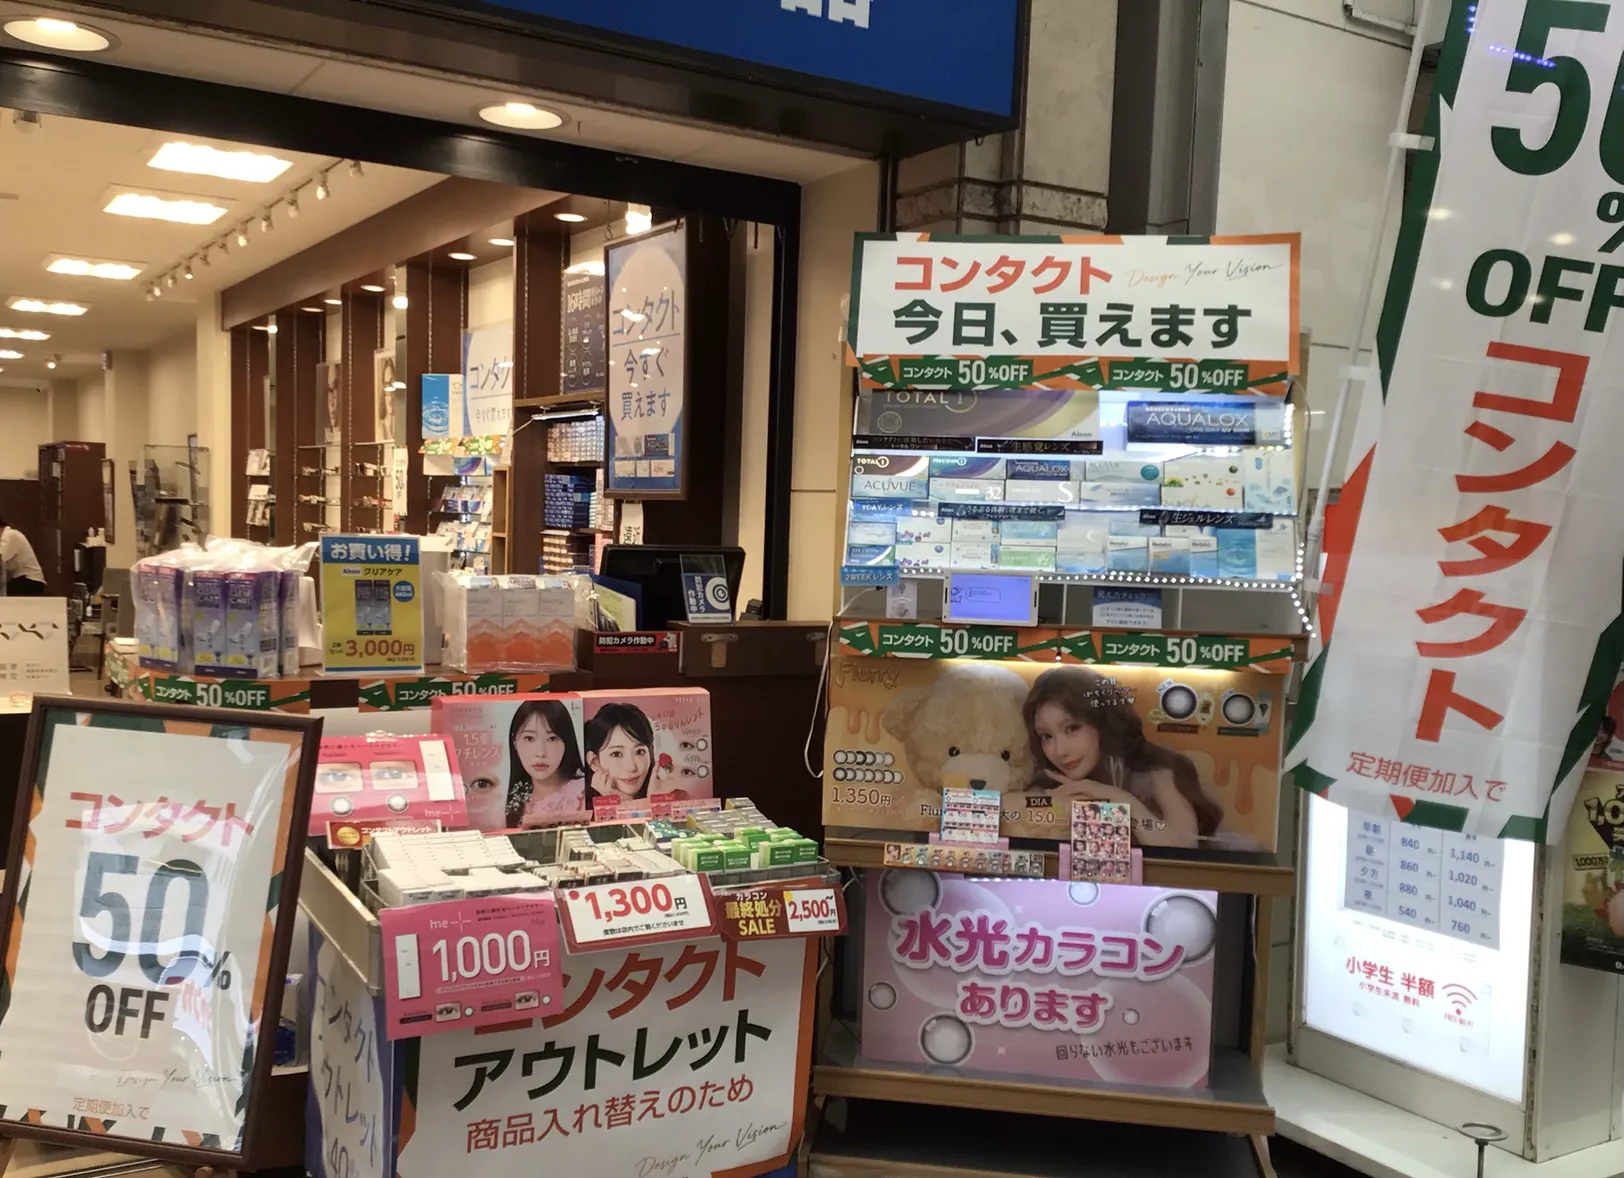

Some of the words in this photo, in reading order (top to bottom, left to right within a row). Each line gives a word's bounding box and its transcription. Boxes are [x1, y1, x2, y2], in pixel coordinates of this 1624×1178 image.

[1491, 0, 1624, 185] 5
[895, 256, 1112, 295] コンタクト
[1125, 269, 1179, 288] Design
[1184, 261, 1220, 282] Your
[1226, 258, 1284, 281] Vision
[1466, 249, 1624, 333] OFF
[612, 290, 680, 336] コンタクト
[893, 299, 1252, 349] 今日、買えます
[624, 347, 669, 384] 今すぐ
[903, 366, 953, 380] コンタクト
[958, 360, 1028, 385] 50%OFF
[1112, 369, 1164, 383] コンタクト
[1170, 362, 1244, 388] 50%OFF
[621, 388, 671, 421] 買えます
[885, 391, 949, 404] TOTAL
[1147, 412, 1249, 427] AQUALOX
[1016, 464, 1069, 473] AQUALOX
[864, 479, 917, 493] ACUVUE
[985, 486, 1002, 500] 32
[1058, 481, 1074, 502] S
[1416, 341, 1590, 743] コンタクト
[363, 568, 403, 576] クリアケア
[346, 639, 415, 658] 3,000円
[882, 634, 934, 649] コンタクト
[939, 629, 1014, 655] 50%OFF
[1106, 643, 1161, 657] コンタクト
[1167, 638, 1244, 664] 50%OFF
[836, 663, 900, 690] Flurry
[156, 685, 192, 701] コンタクト
[1346, 751, 1509, 802] 定期便加入で
[832, 786, 892, 806] 1,350円
[1031, 797, 1049, 806] DIA
[65, 791, 254, 847] コンタクト
[1401, 837, 1420, 850] 840
[1400, 860, 1419, 873] 860
[1451, 848, 1480, 864] 1,140
[1399, 882, 1418, 896] 880
[1449, 870, 1478, 886] 1,020
[736, 891, 768, 901] カラコン
[1448, 895, 1476, 912] 1,040
[725, 899, 782, 919] 最終処分
[1398, 905, 1417, 919] 540
[738, 919, 776, 936] SALE
[1451, 919, 1470, 934] 760
[897, 911, 1185, 975] 水光カラコン
[432, 929, 551, 982] 1,000円
[1346, 956, 1394, 986] 小学生
[1400, 972, 1435, 999] 半額
[85, 984, 169, 1039] OFF
[960, 982, 1109, 1028] あります
[1056, 1036, 1194, 1060] 回らない水光もございます
[453, 1009, 772, 1112] アウトレット
[160, 1068, 189, 1089] Your
[72, 1097, 150, 1120] 定期便加入で
[465, 1075, 754, 1153] 商品入れ替えのため
[636, 1154, 692, 1178] Design
[696, 1138, 730, 1166] Your
[734, 1121, 789, 1152] Vision
